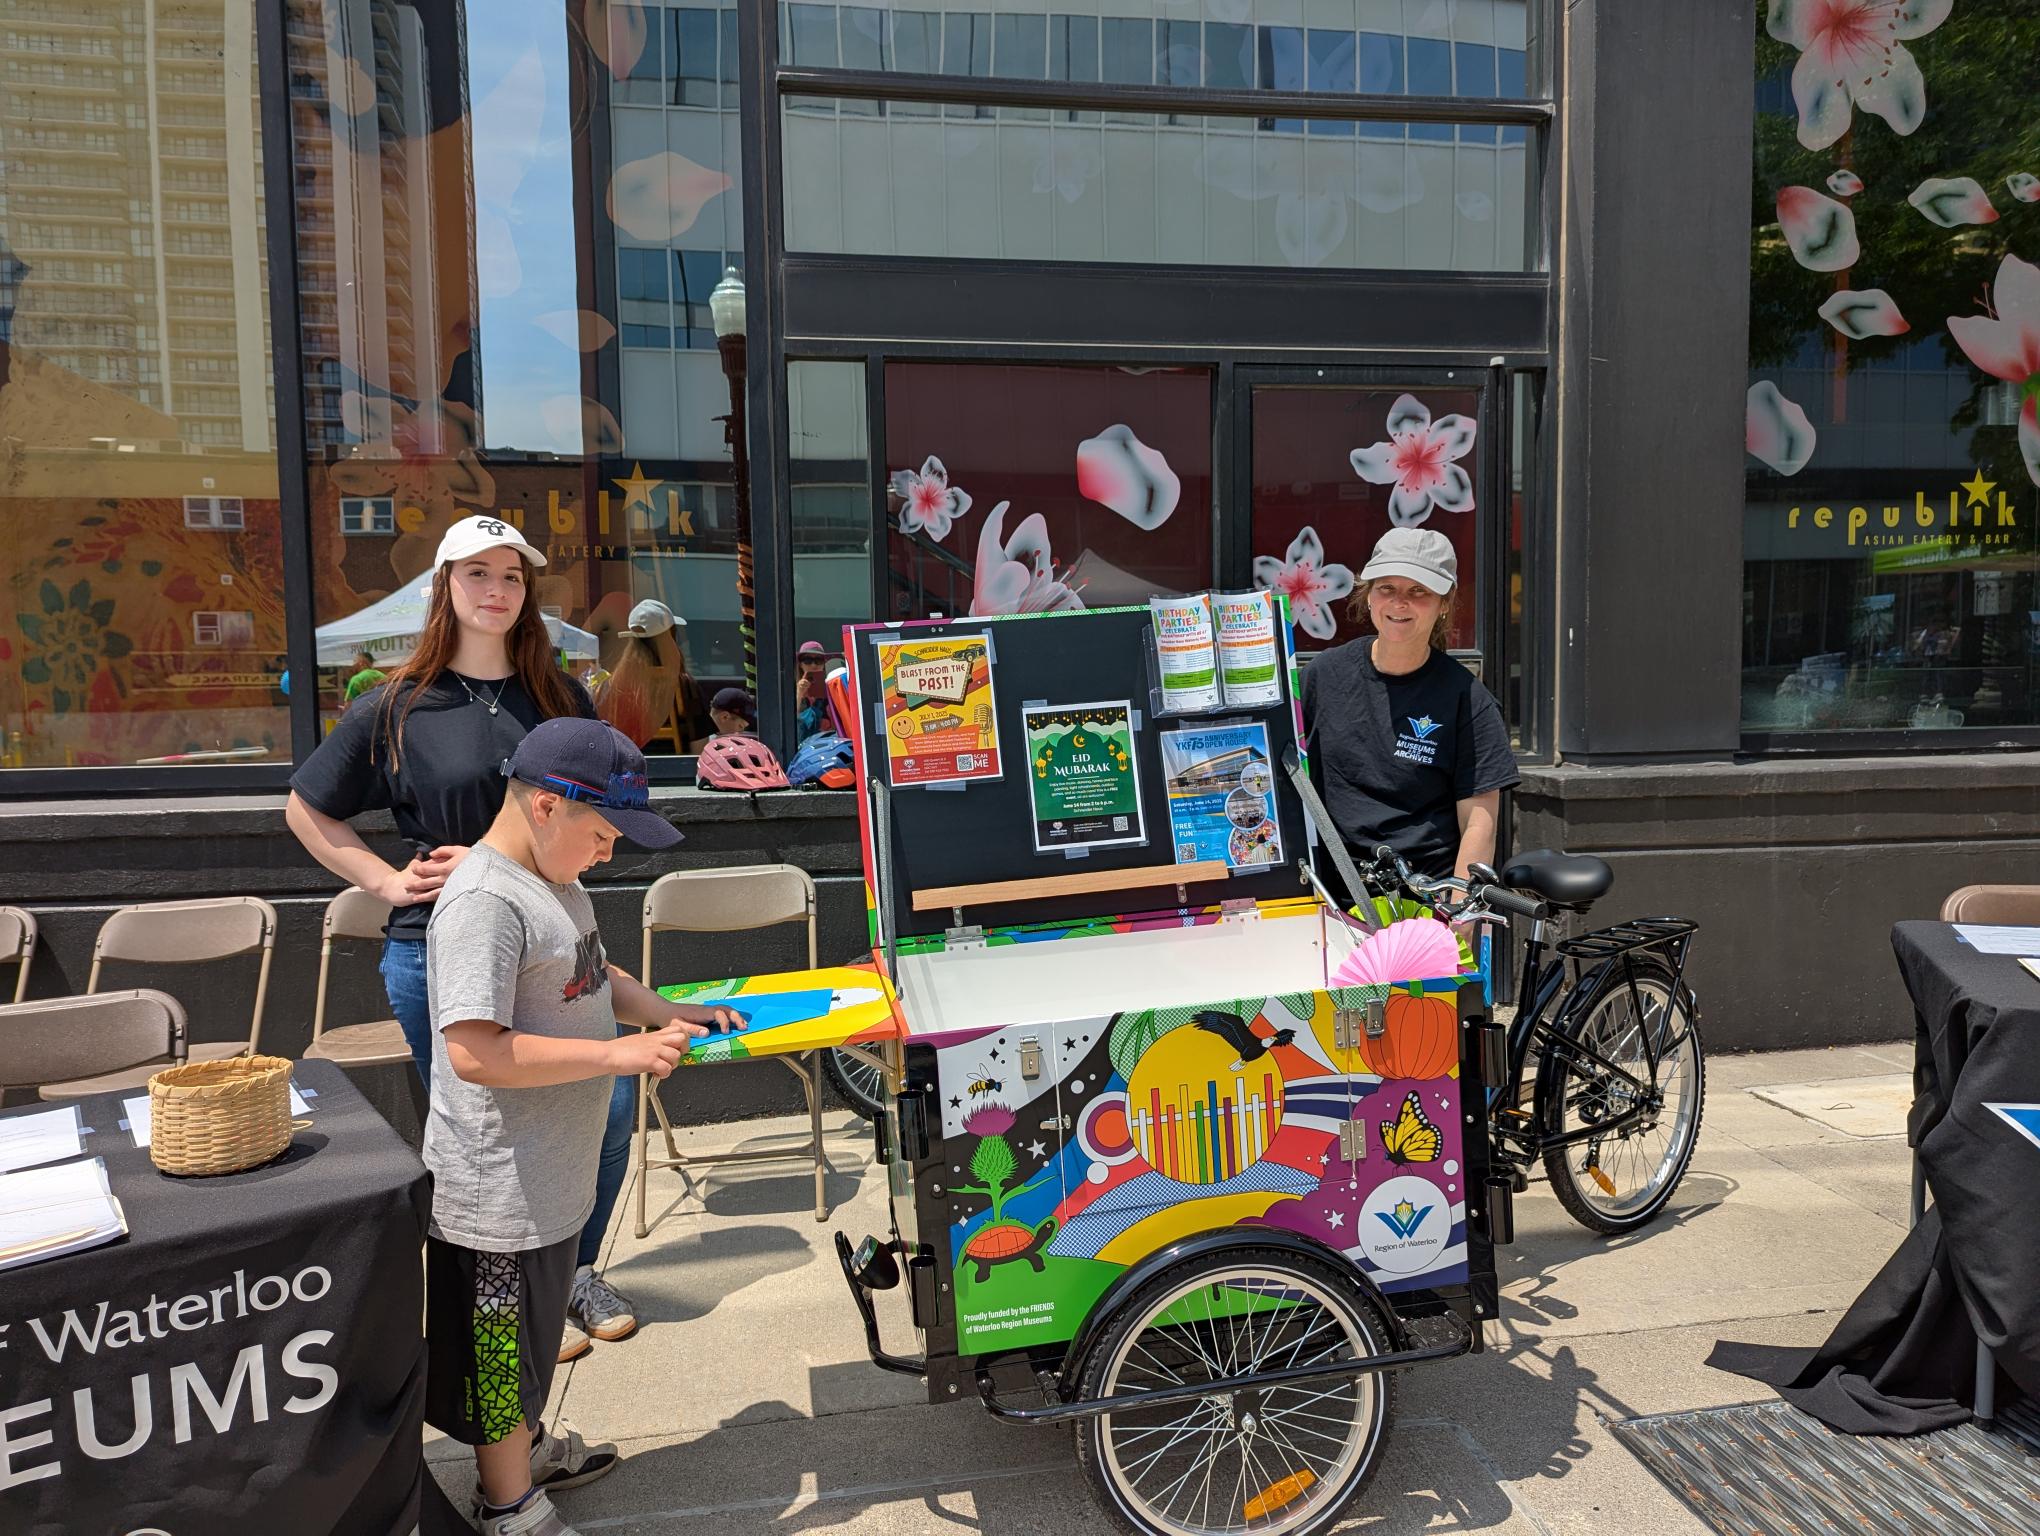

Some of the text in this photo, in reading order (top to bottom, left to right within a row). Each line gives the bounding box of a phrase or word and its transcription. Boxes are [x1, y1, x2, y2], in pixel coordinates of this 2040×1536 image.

[362, 489, 696, 536] reublik
[1788, 491, 2016, 545] republik
[1864, 534, 2010, 545] ASIAN EATERY & BAR
[547, 546, 614, 558] EATERY
[653, 546, 687, 557] BAR
[1158, 606, 1200, 618] BIRTHDAY
[1218, 602, 1261, 614] BIRTHDAY
[1161, 616, 1200, 628] PARTIES!
[1221, 612, 1261, 623] PARTIES!
[901, 664, 965, 678] BLAST FROM THE
[918, 676, 954, 691] PAST!
[1205, 732, 1251, 742] ANNIVERSARY
[1205, 738, 1248, 749] OPEN HOUSE
[1396, 740, 1436, 755] MUSEUMS
[973, 759, 989, 768] ME
[1072, 753, 1091, 763] EID
[1394, 750, 1433, 764] ARCHIVES
[1054, 763, 1110, 777] MUBARAK
[1374, 1243, 1398, 1253] Region
[1407, 1238, 1438, 1248] Waterloo
[26, 1265, 332, 1363] Waterloo
[963, 1302, 1055, 1323] Proudly funded by the FRIENDS
[965, 1315, 1053, 1335] of Waterloo Region Museums
